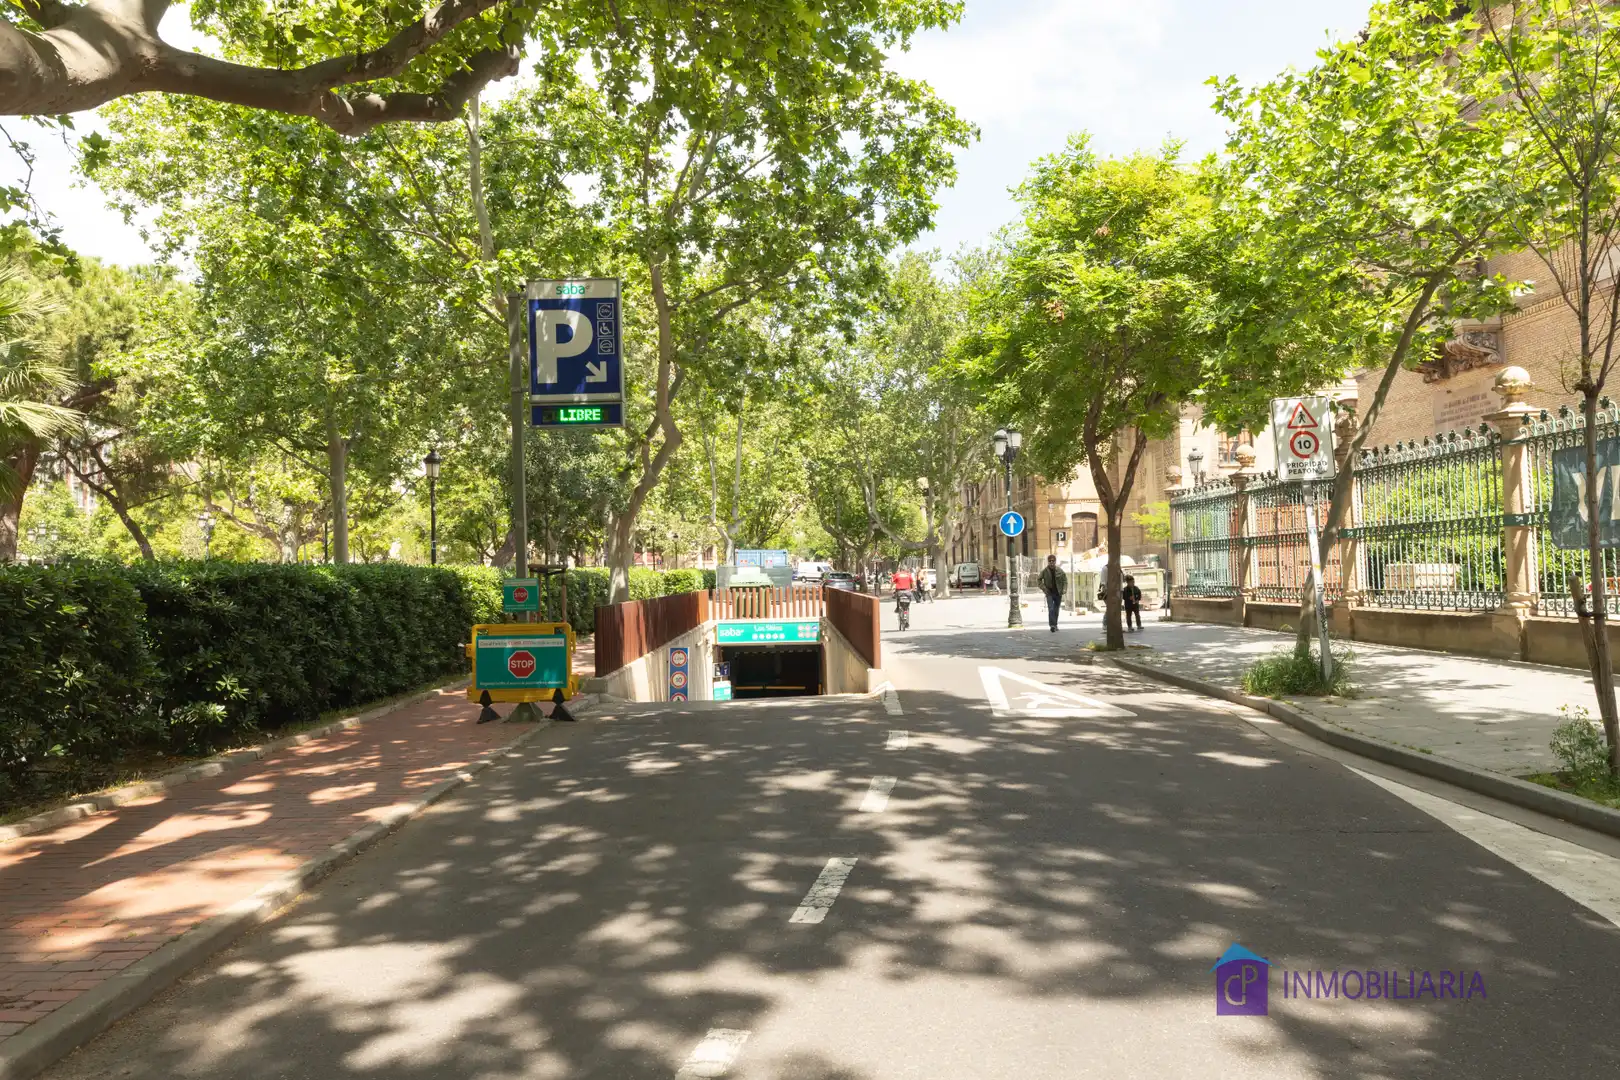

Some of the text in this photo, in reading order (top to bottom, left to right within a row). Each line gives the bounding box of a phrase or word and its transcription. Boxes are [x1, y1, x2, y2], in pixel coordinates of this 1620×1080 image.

[535, 309, 594, 384] P
[560, 408, 601, 421] LIBRE
[1297, 439, 1312, 450] 10
[1286, 461, 1328, 469] PRIORIDAD
[510, 660, 534, 669] STOP
